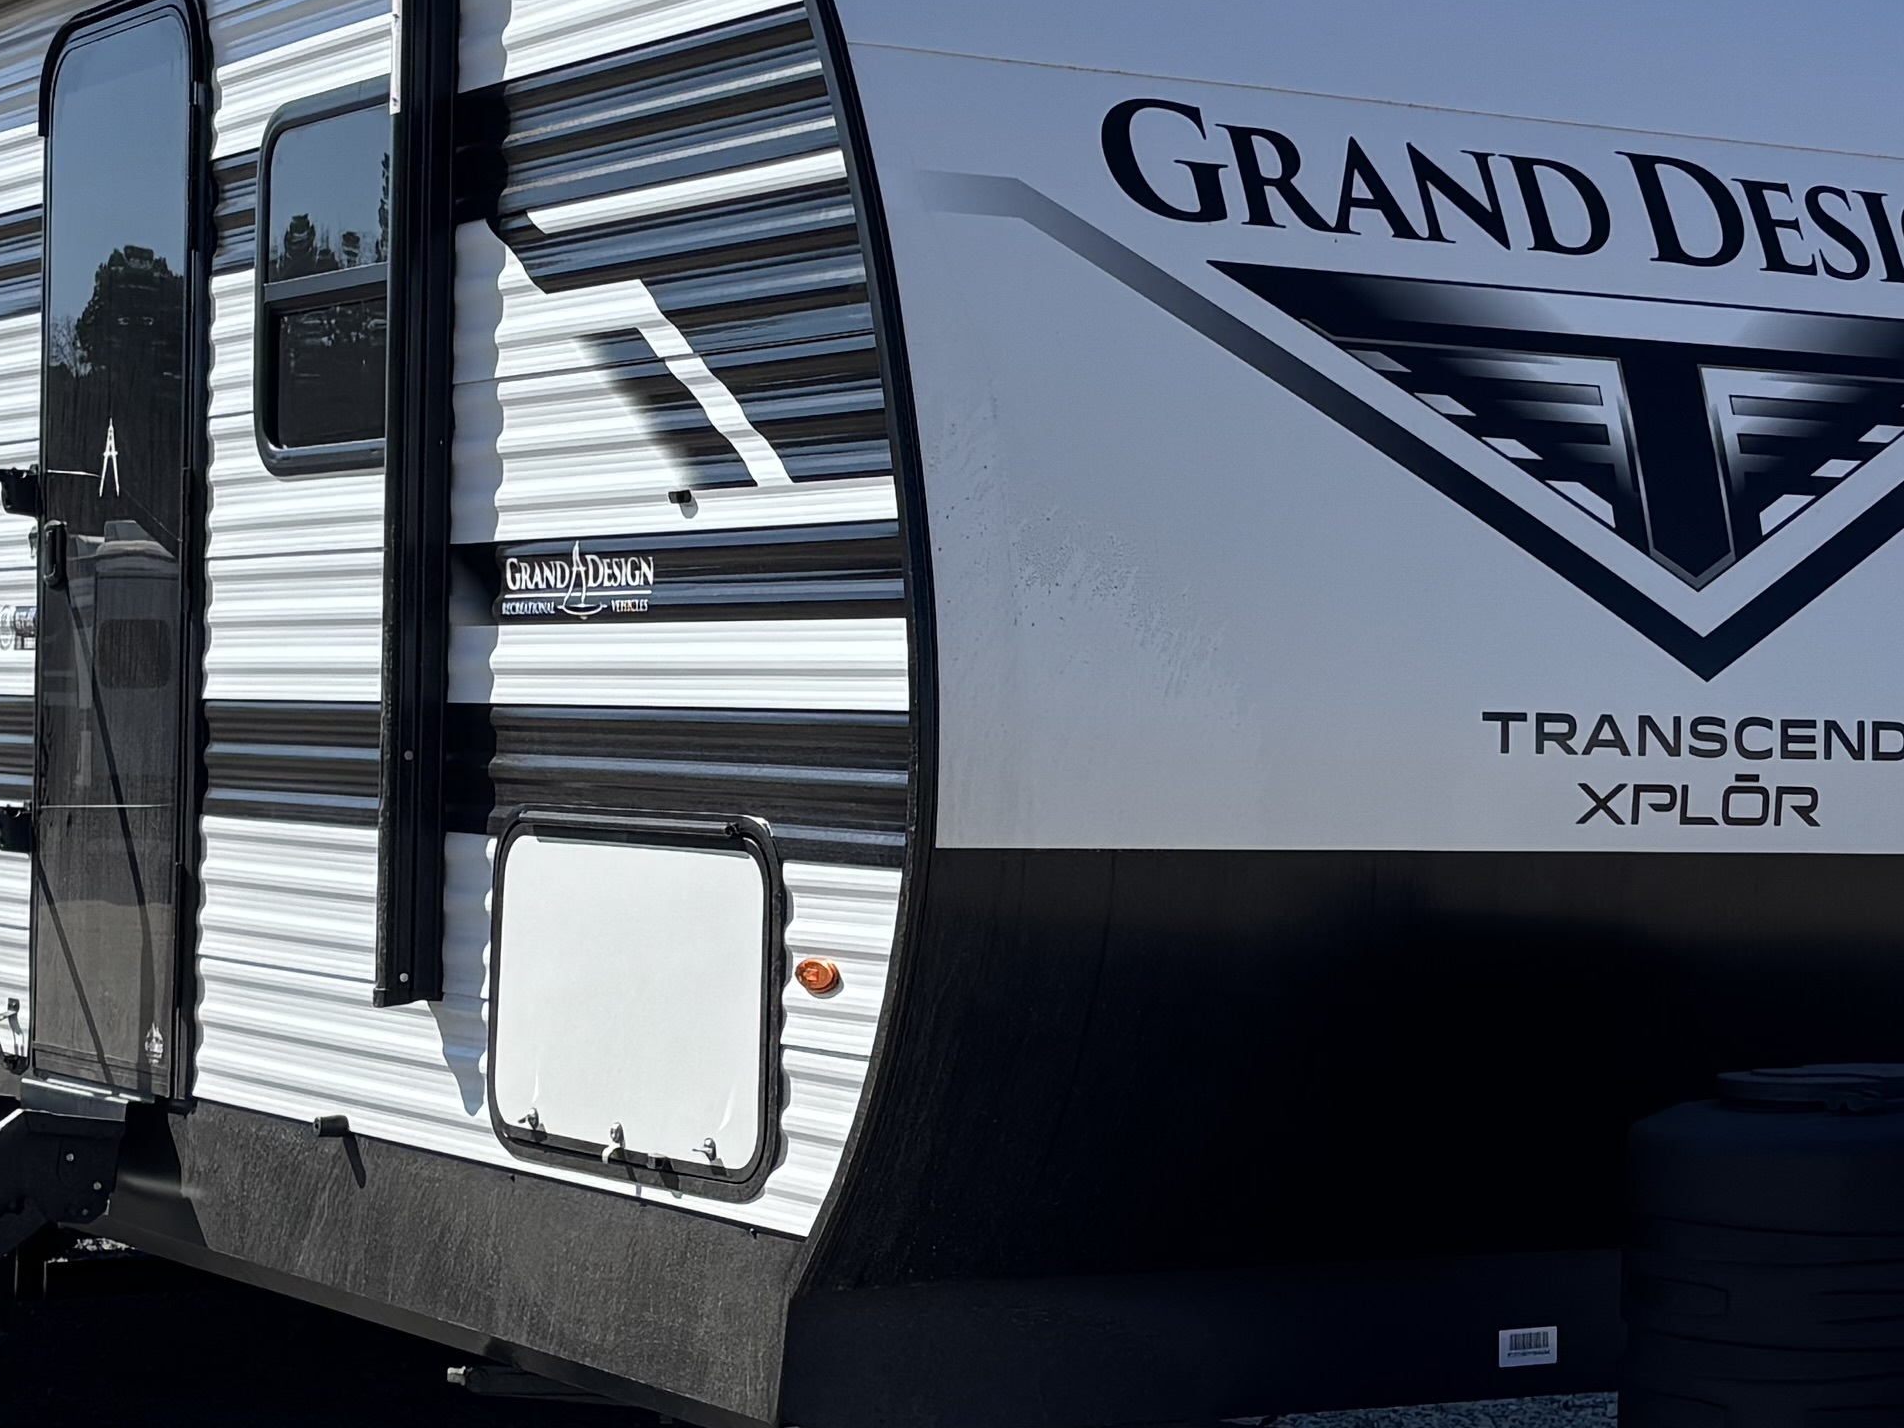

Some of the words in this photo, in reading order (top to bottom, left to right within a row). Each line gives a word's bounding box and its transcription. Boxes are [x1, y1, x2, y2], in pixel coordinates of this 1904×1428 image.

[1099, 97, 1612, 256] GRAND
[504, 557, 570, 591] GRAND
[584, 554, 655, 588] DESIGN
[610, 599, 649, 613] VEHICLES
